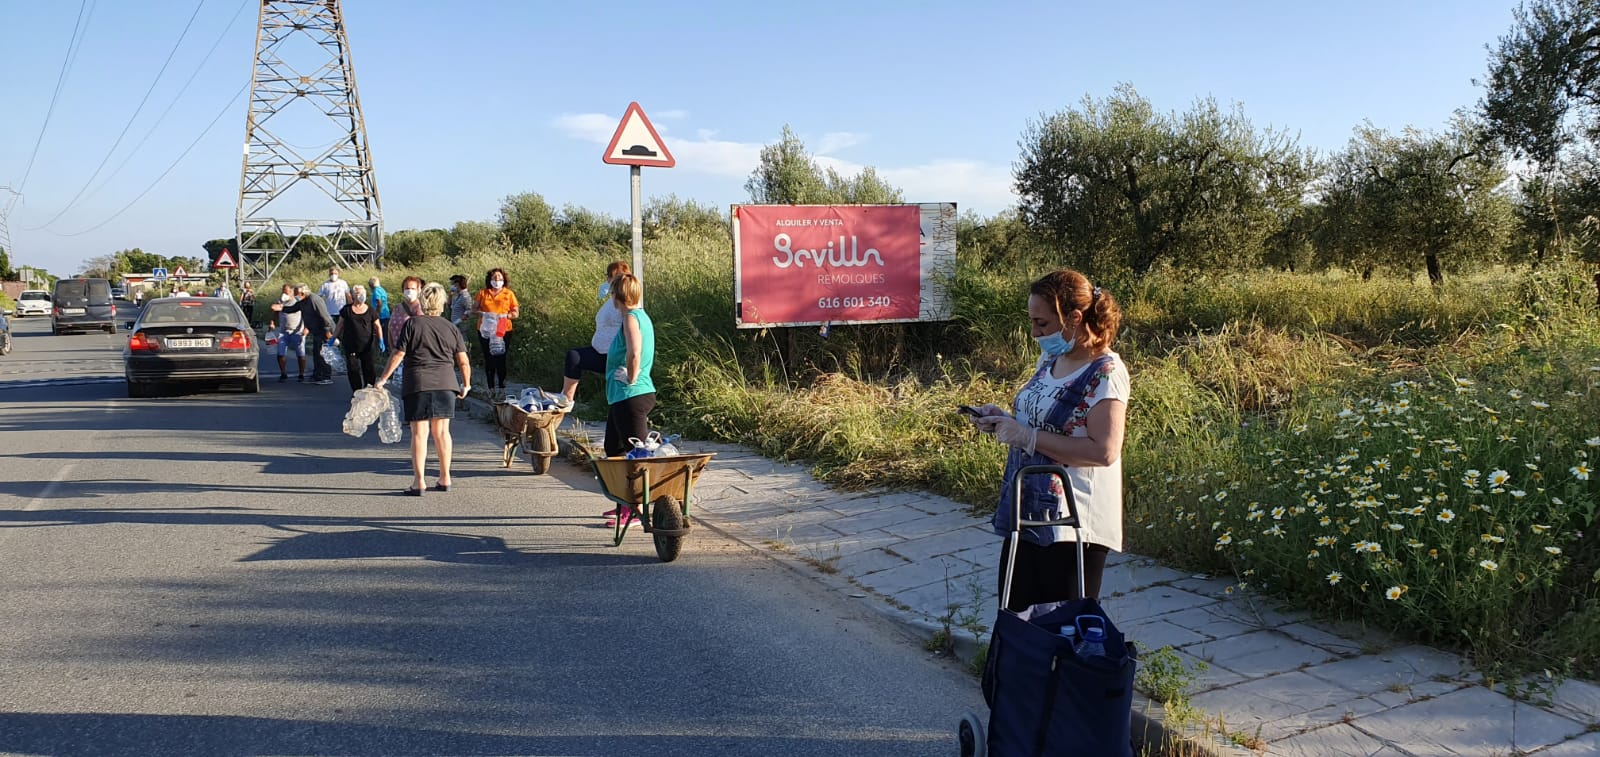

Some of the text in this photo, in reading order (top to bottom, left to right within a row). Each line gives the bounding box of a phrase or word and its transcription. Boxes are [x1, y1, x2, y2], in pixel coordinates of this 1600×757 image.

[776, 219, 812, 227] ALQUILER
[773, 233, 884, 268] Sevilla
[818, 274, 884, 285] REMOLQUES
[818, 296, 890, 308] 616 601 340
